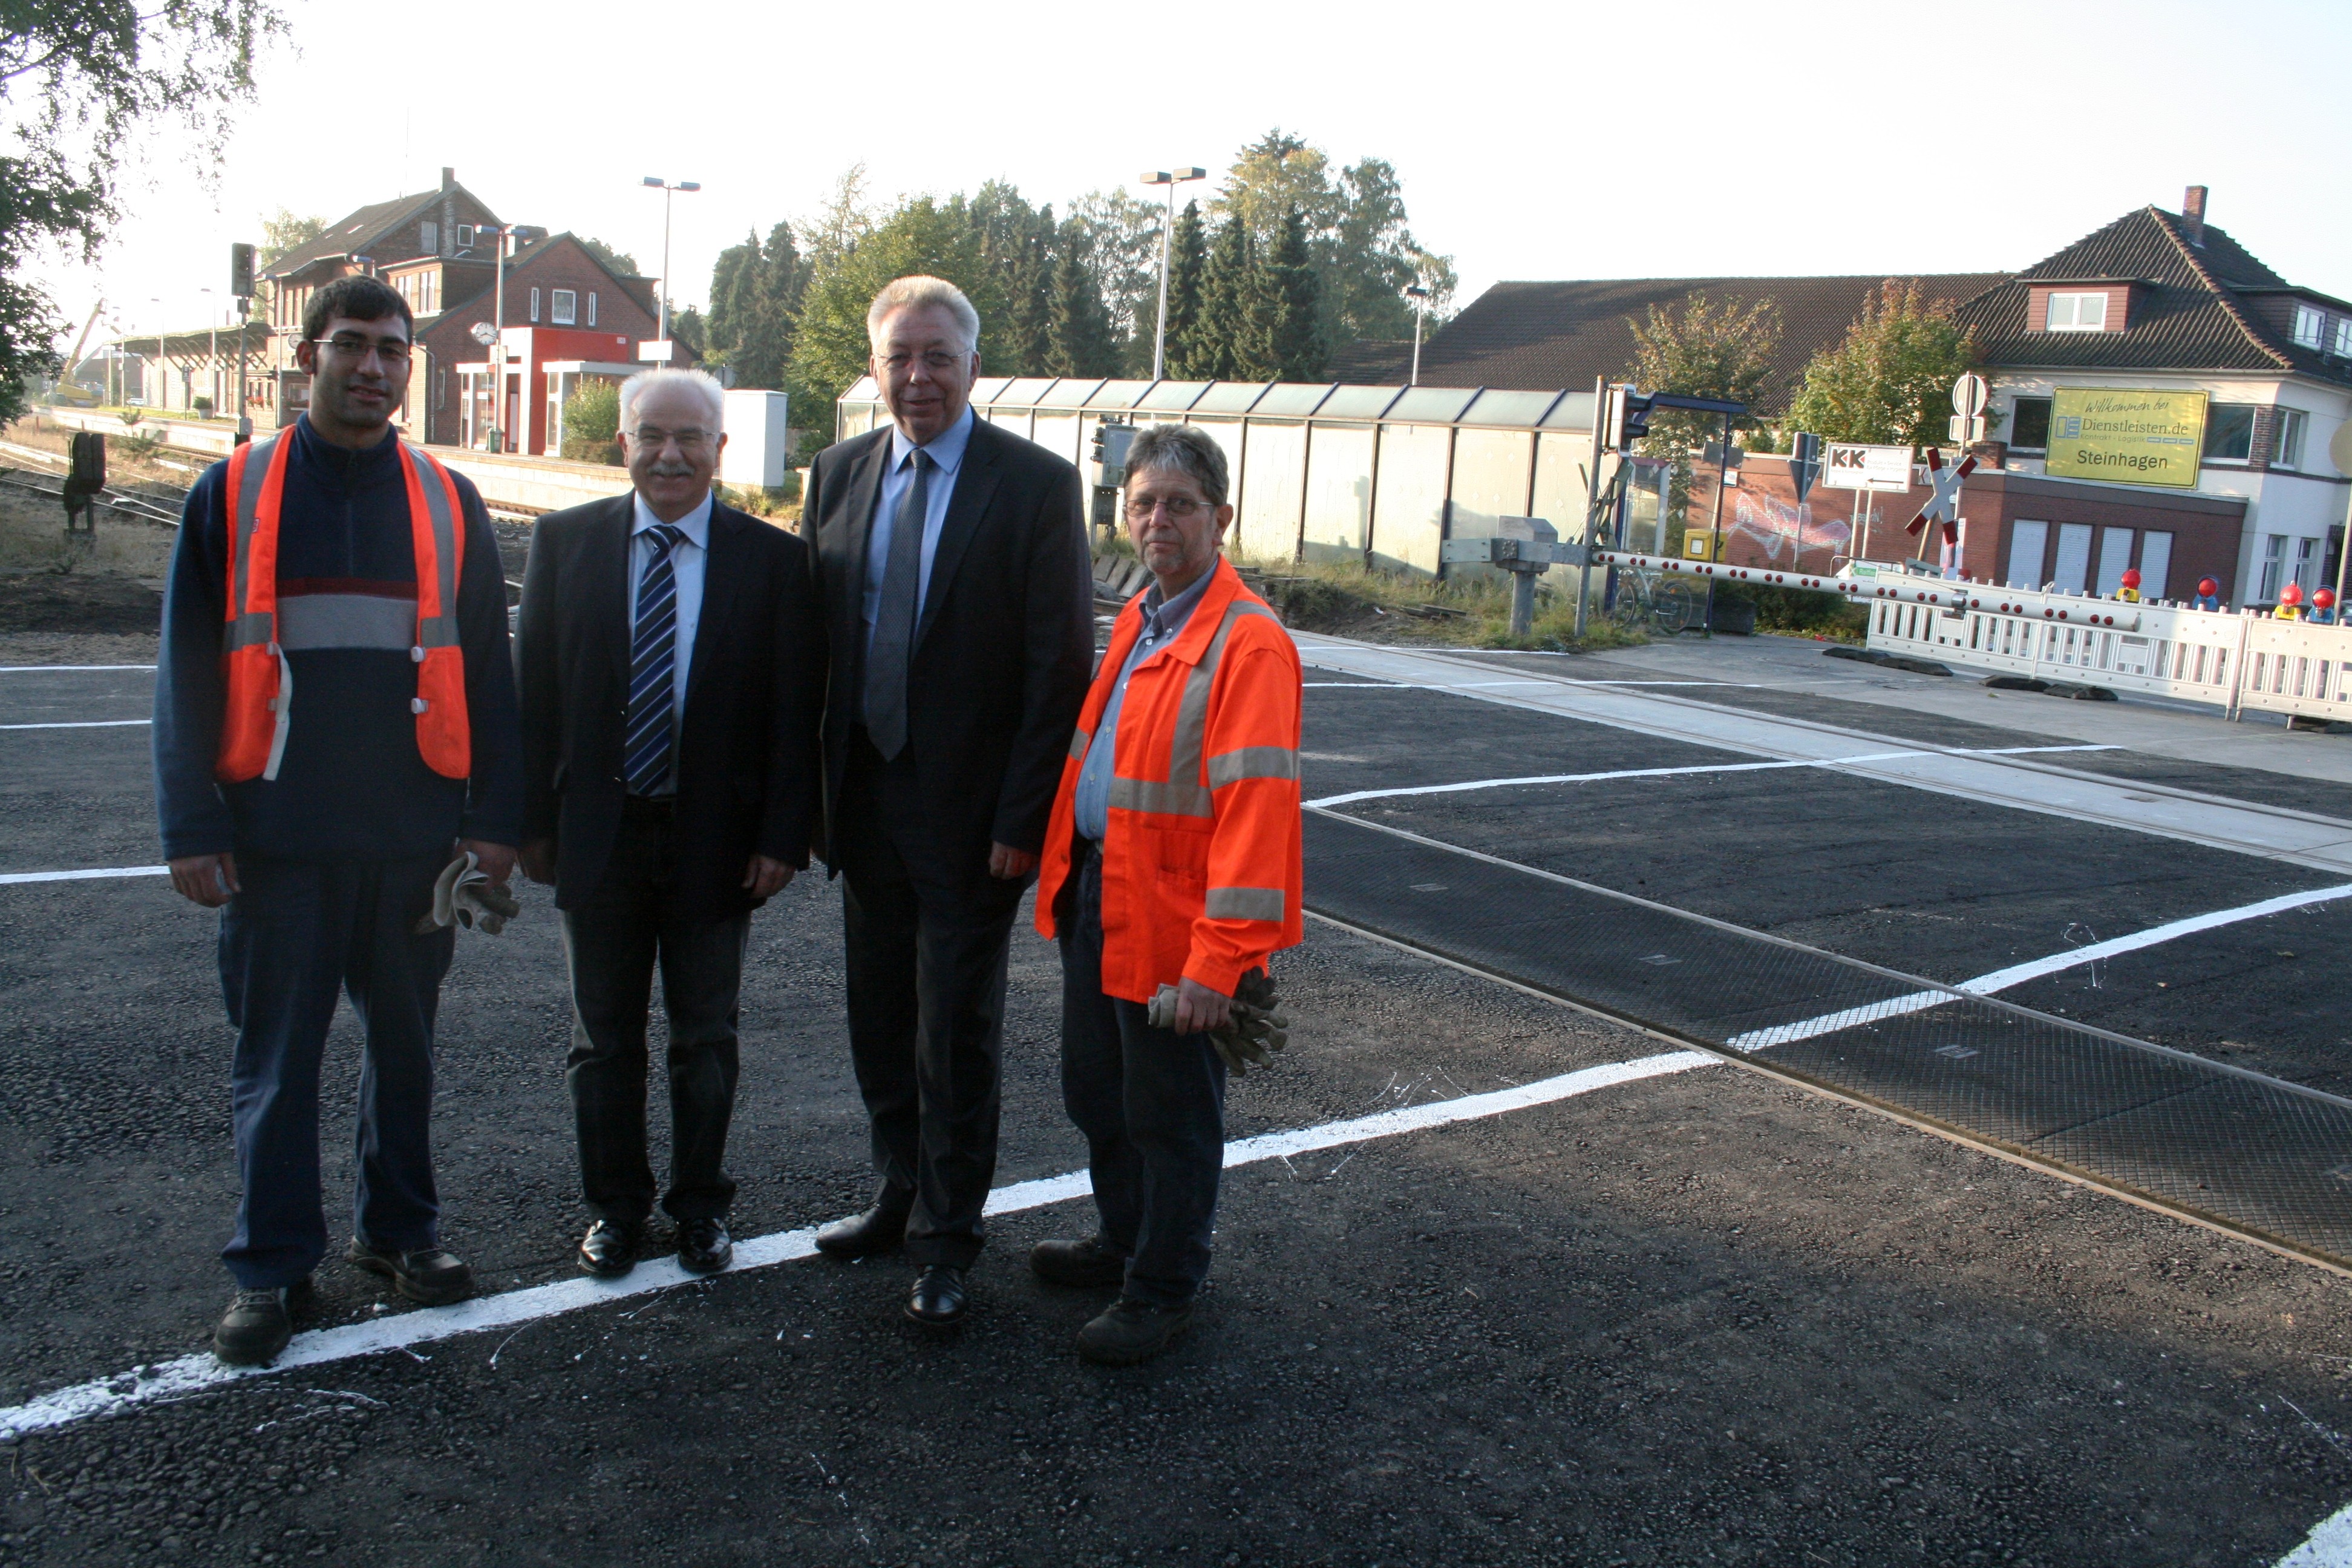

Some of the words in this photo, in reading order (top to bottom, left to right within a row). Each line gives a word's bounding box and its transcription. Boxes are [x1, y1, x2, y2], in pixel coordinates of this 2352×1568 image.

[2085, 397, 2150, 413] Willkommen
[2153, 397, 2171, 410] bei
[2082, 418, 2188, 436] Dienstleisten.de
[2118, 434, 2146, 443] Logistik
[1831, 449, 1866, 469] KK
[2077, 450, 2167, 471] Steinhagen
